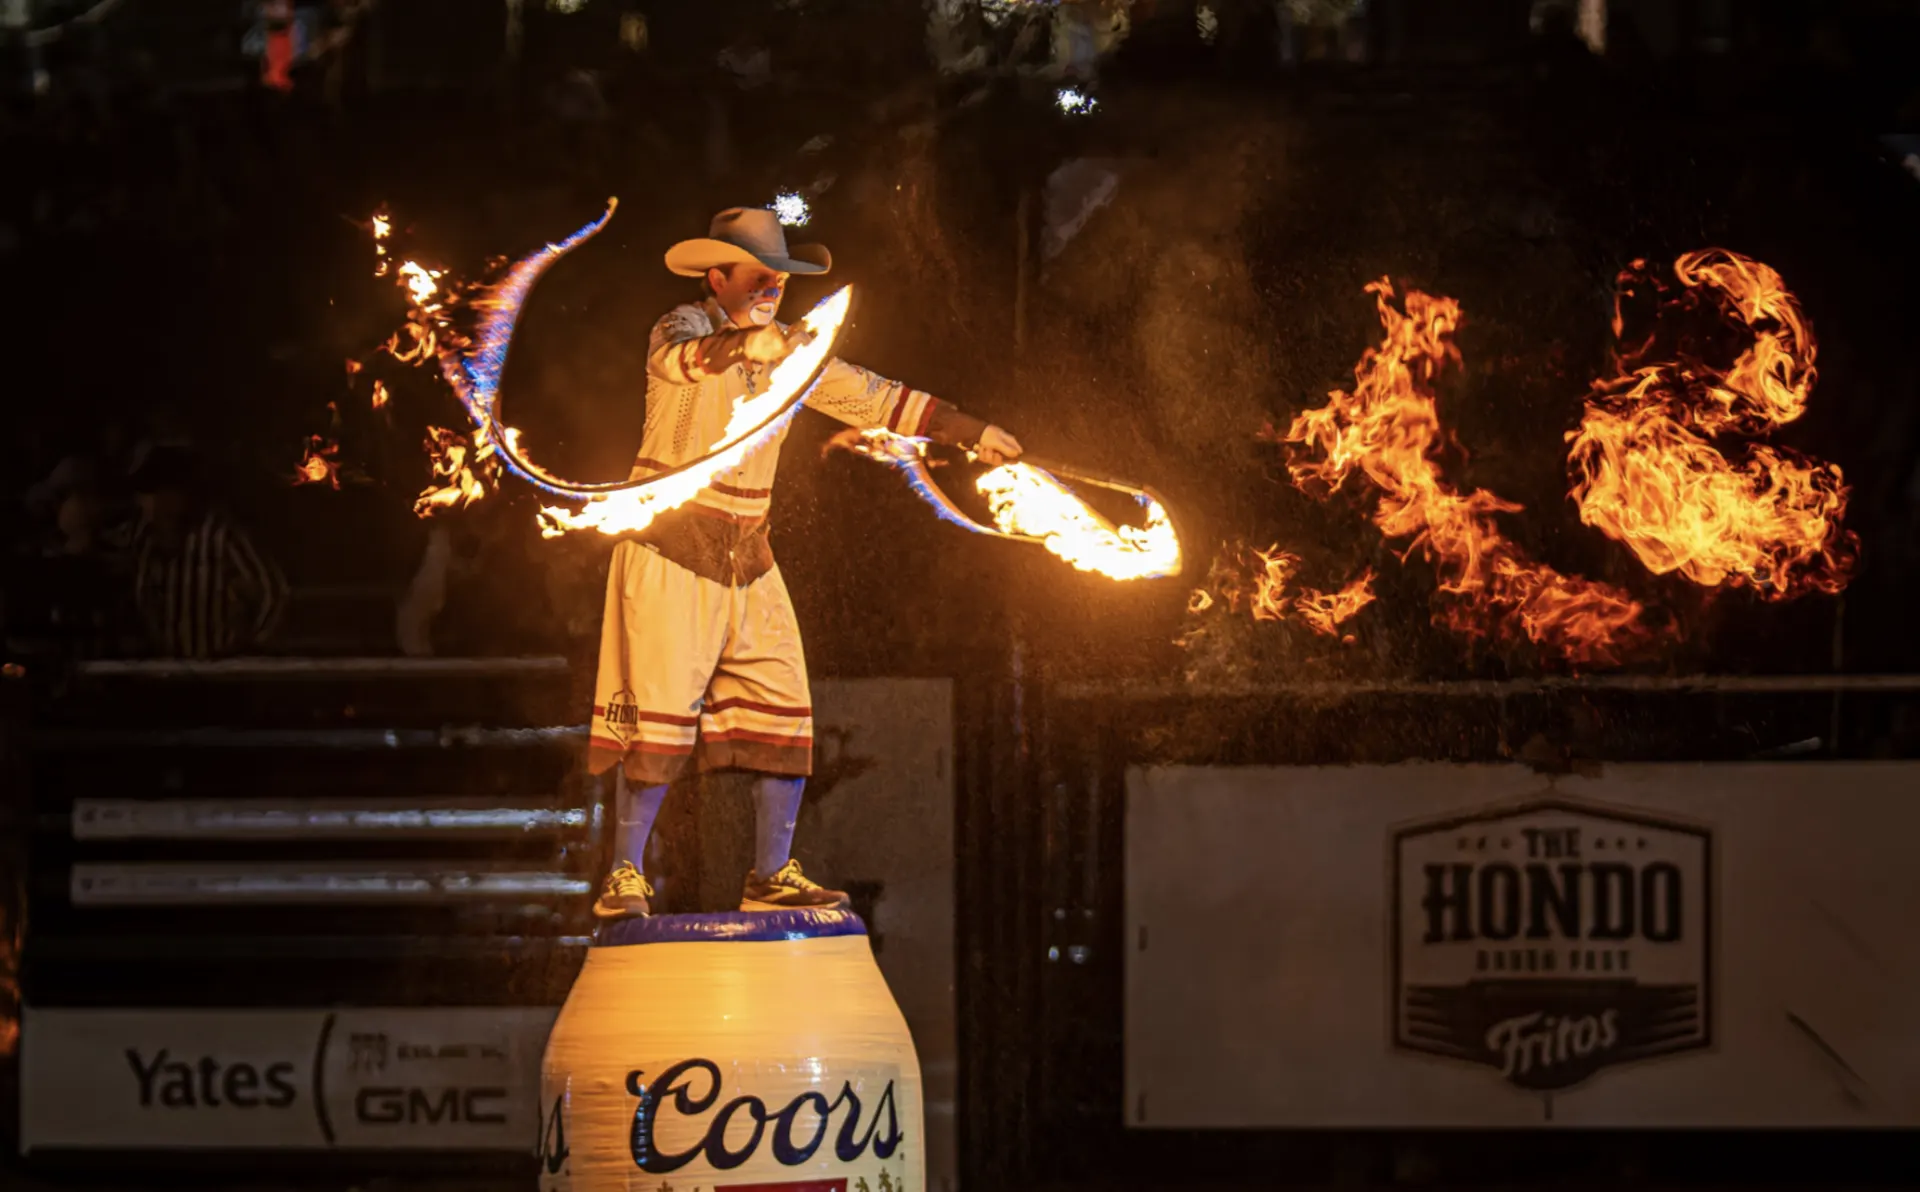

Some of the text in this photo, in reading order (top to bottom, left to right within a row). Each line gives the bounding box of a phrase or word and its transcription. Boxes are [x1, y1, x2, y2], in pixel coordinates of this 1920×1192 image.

[1521, 828, 1580, 858] THE
[1422, 862, 1682, 943] HONDO
[1485, 1007, 1619, 1076] Fritos
[126, 1049, 297, 1109] Yates
[357, 1088, 508, 1124] GMC
[627, 1058, 904, 1174] Coors
